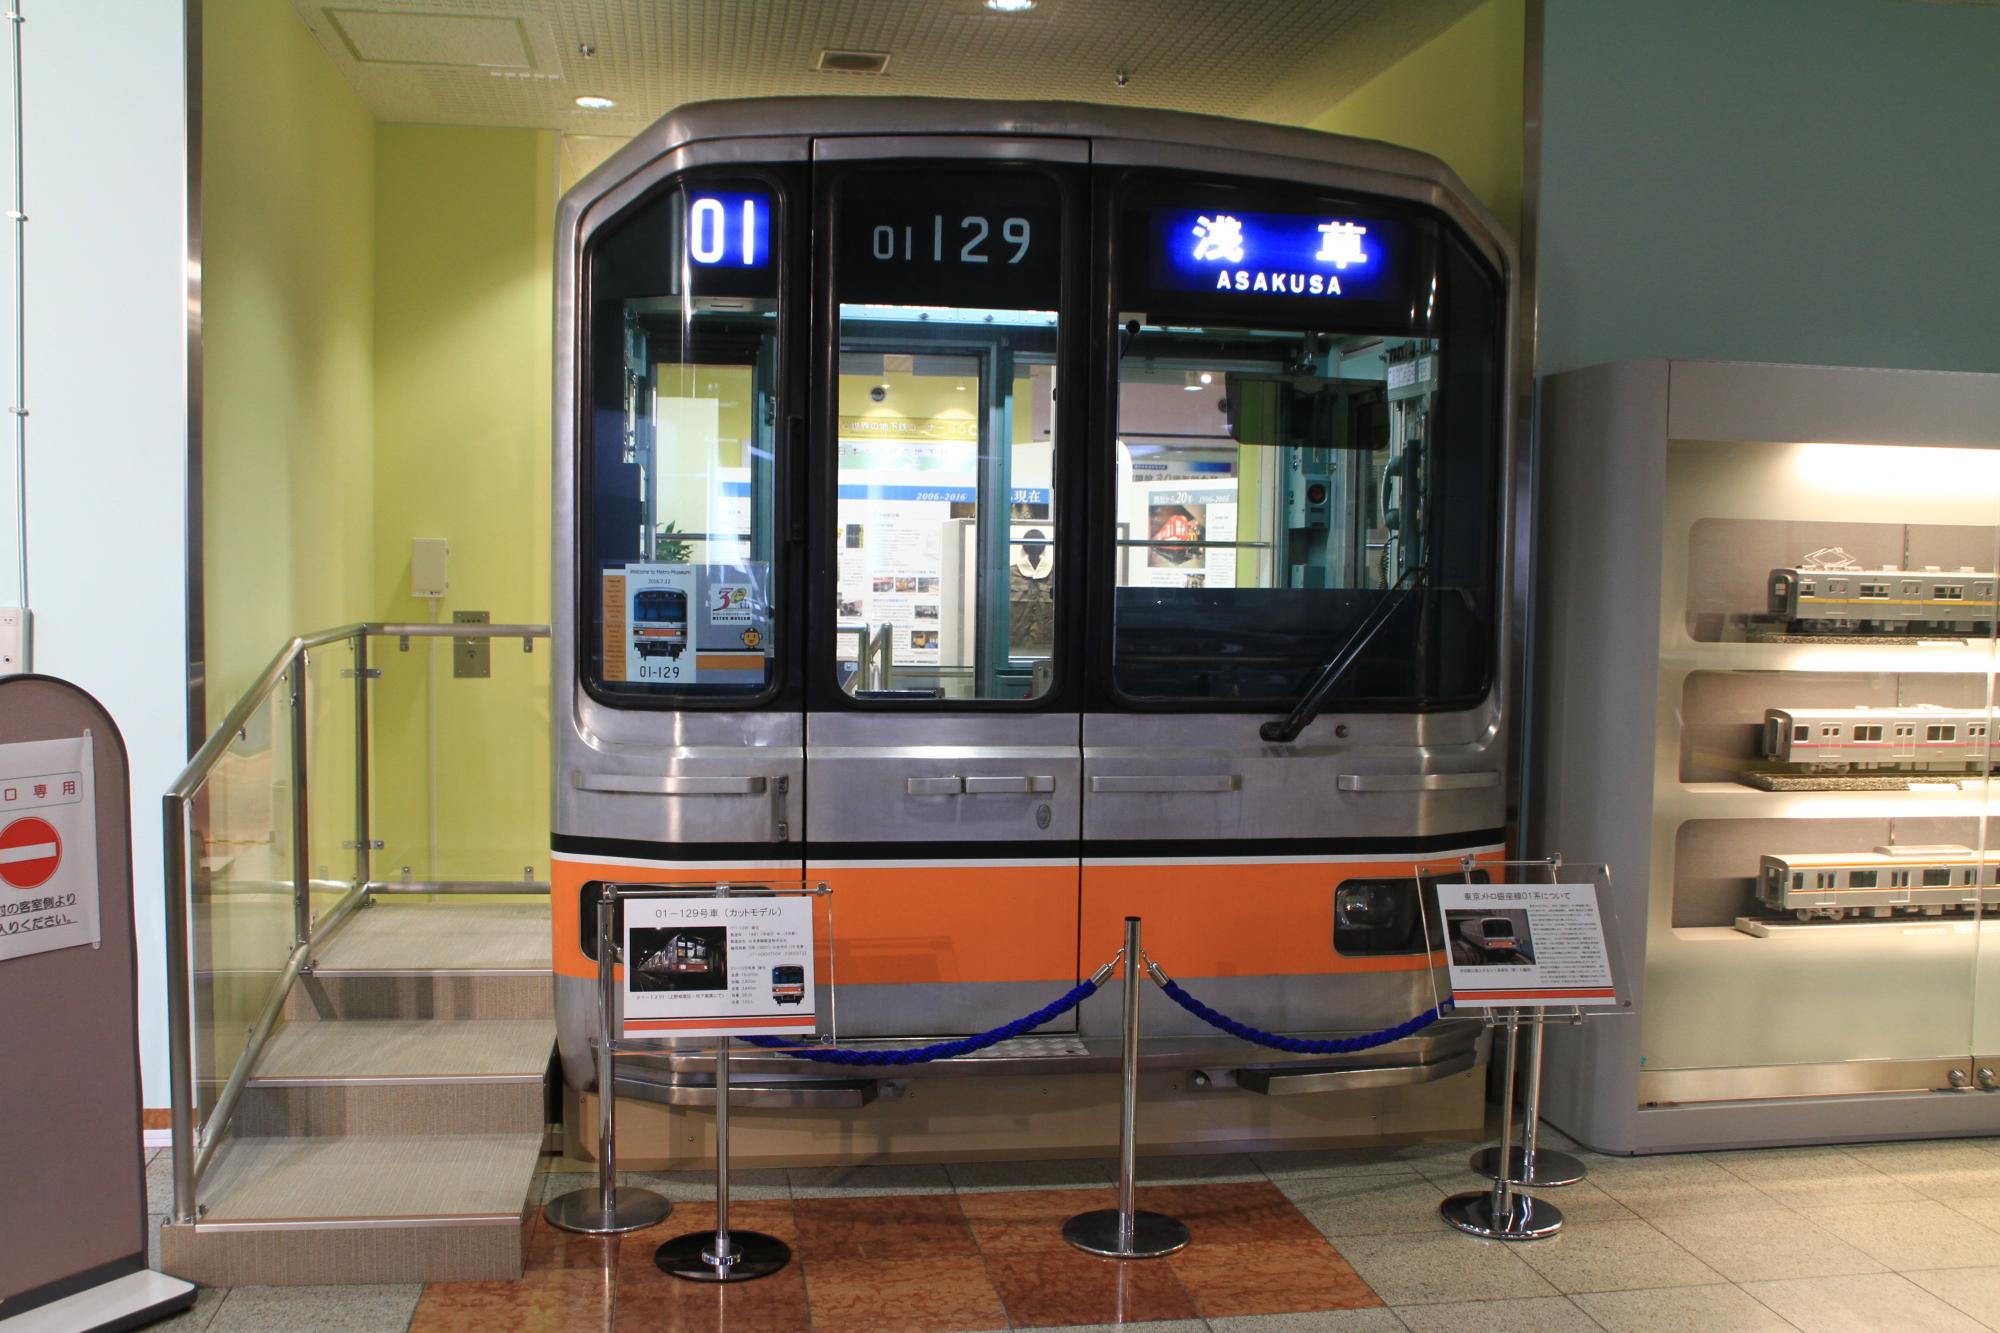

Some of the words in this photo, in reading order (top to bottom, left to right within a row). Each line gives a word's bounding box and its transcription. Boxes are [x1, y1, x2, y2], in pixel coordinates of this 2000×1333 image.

[691, 198, 755, 265] 01
[1217, 270, 1342, 295] ASAKUSA
[639, 666, 680, 679] 01-129
[1463, 892, 1571, 901] 東京メトロ銀座線01系について
